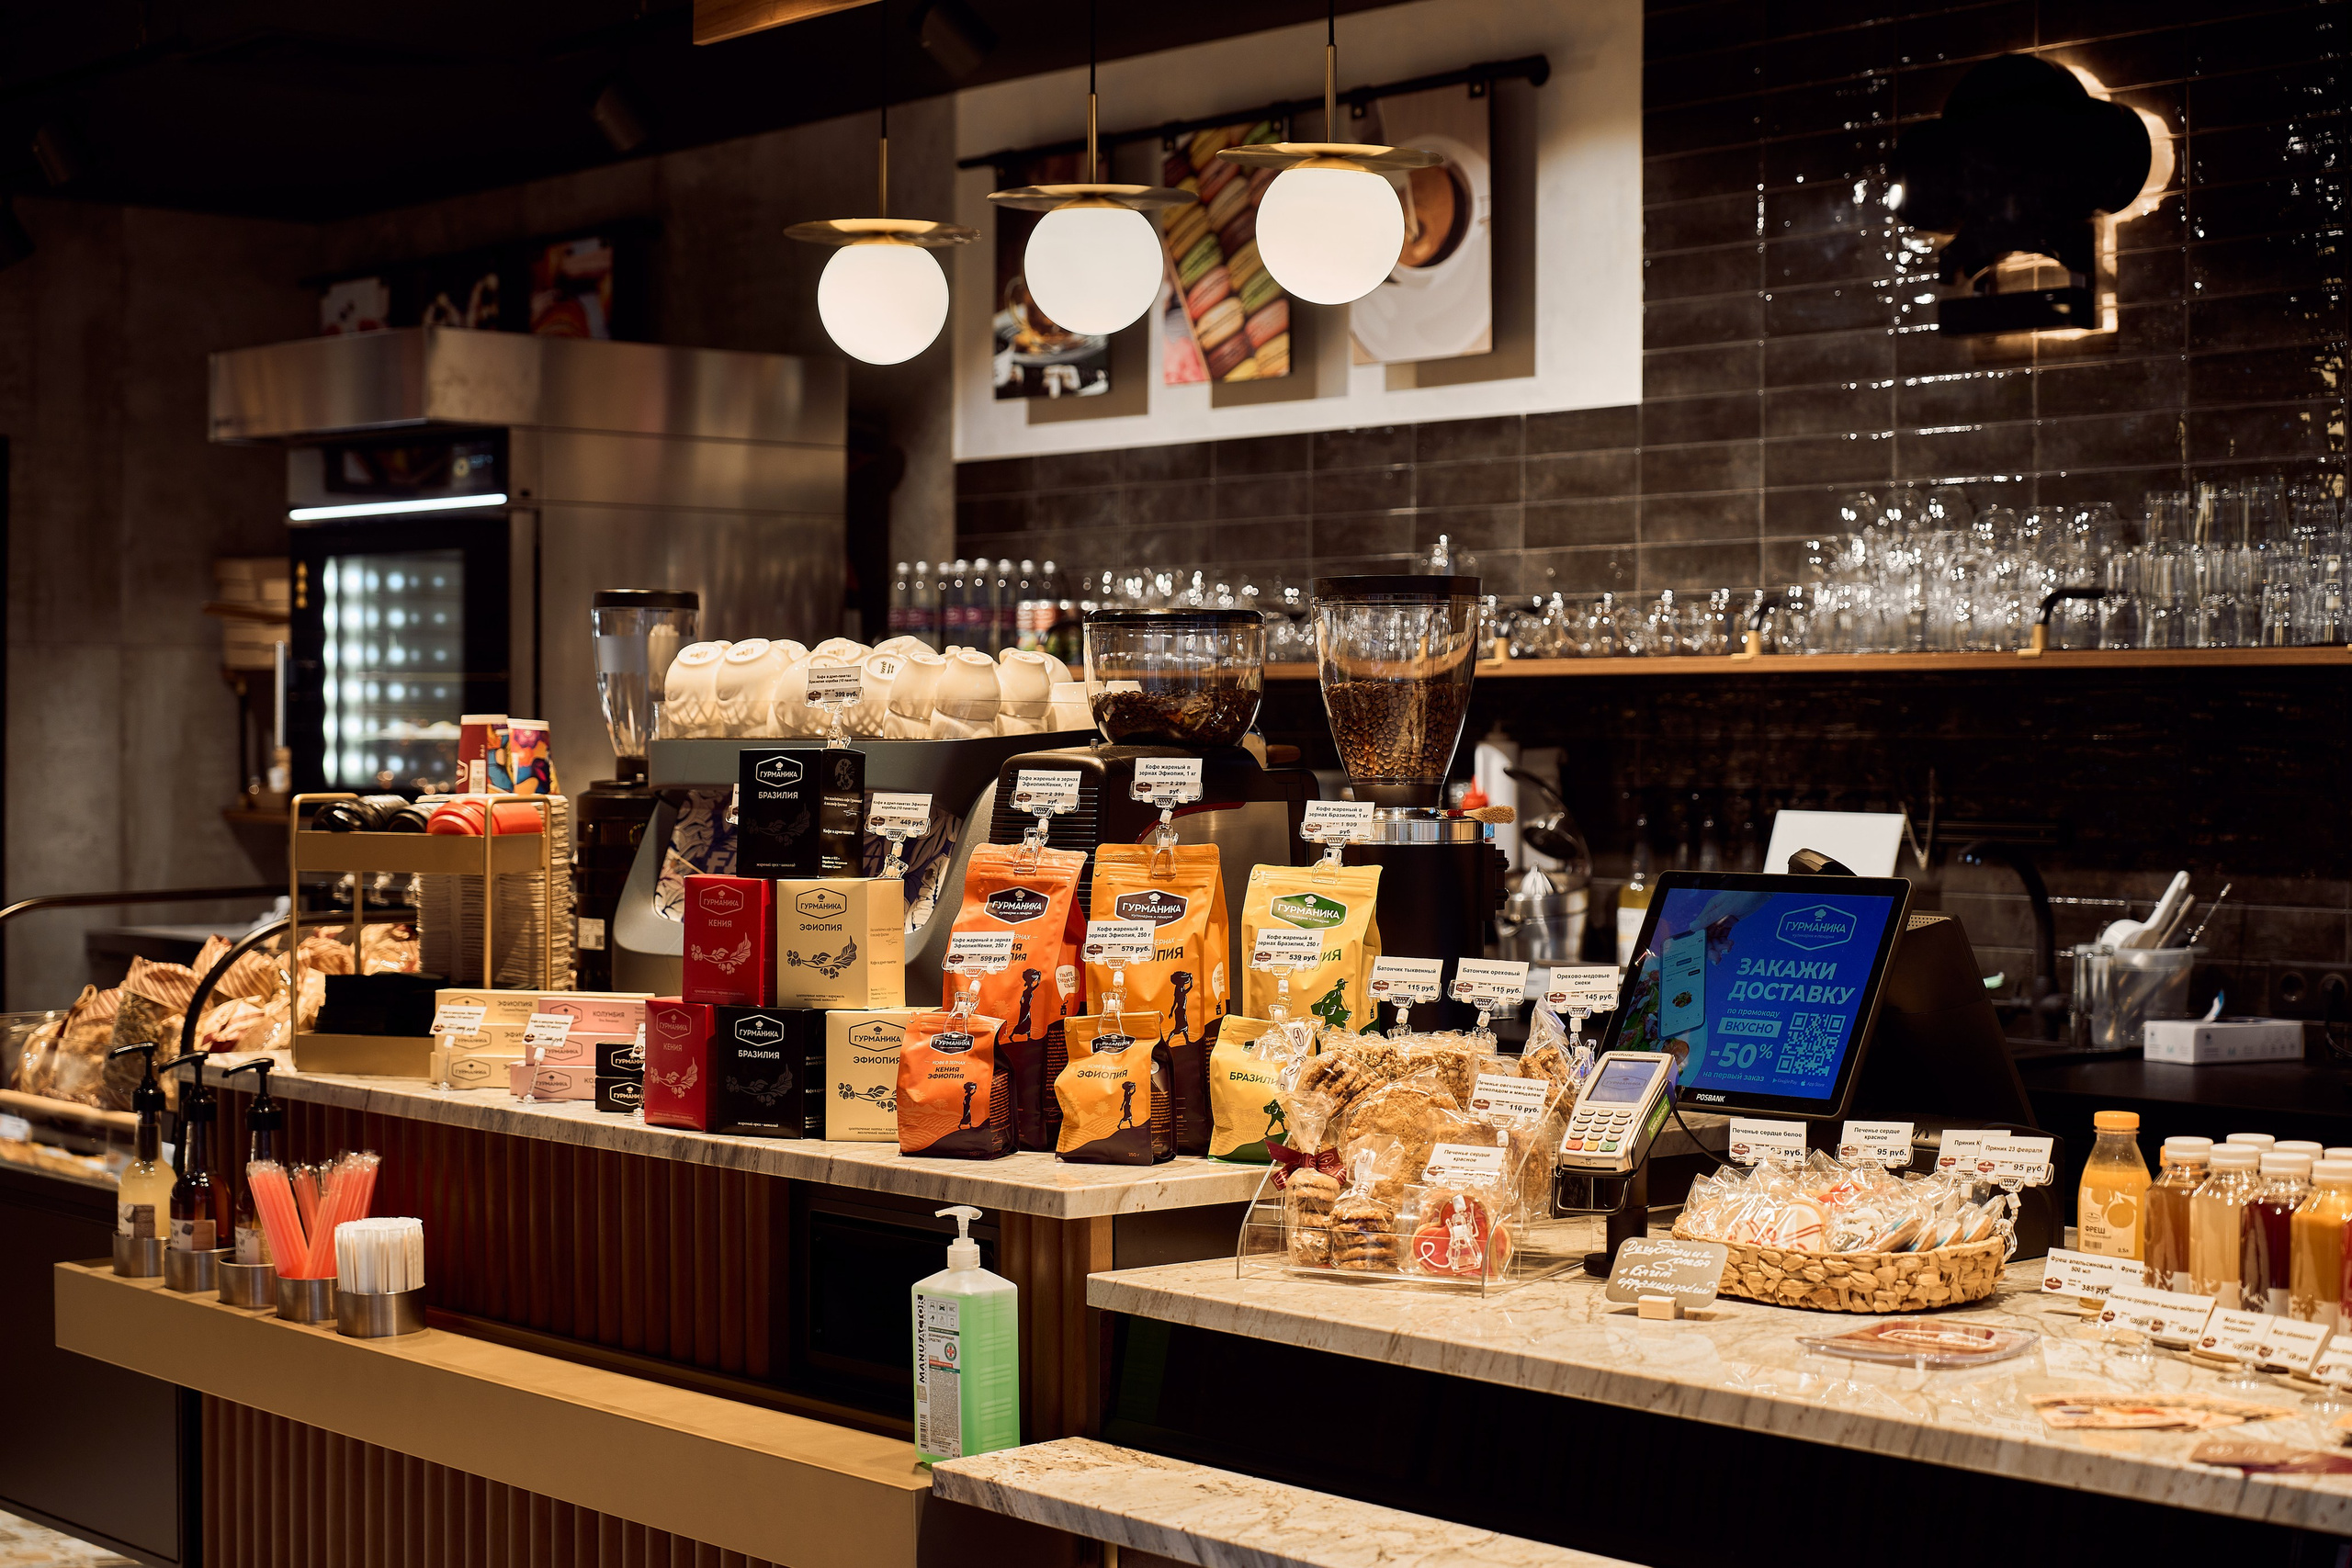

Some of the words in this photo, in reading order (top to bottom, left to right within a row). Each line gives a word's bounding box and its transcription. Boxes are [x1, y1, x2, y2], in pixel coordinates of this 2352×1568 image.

[1161, 763, 1185, 772] жареный
[760, 771, 798, 779] ГУРМАНИКА
[758, 791, 799, 800] БРАЗИЛИЯ
[912, 819, 925, 828] руб.
[703, 897, 740, 908] ГУРМАНИКА
[800, 901, 842, 911] ГУРМАНИКА
[991, 901, 1043, 911] ГУРМАНИКА
[1121, 902, 1182, 914] ГУРМАНИКА
[1277, 904, 1341, 919] ГУРМАНИКА
[707, 919, 733, 929] КЕНИЯ
[799, 923, 842, 932] ЭФИОПИЯ
[1785, 921, 1846, 933] ГУРМАНИКА
[1135, 945, 1150, 953] руб.
[1736, 957, 1838, 980] ЗАКАЖИ
[1599, 993, 1614, 1001] руб.
[1727, 980, 1856, 1005] ДОСТАВКУ
[1737, 1010, 1781, 1019] промокоду
[659, 1021, 688, 1032] ГУРМАНИКА
[1724, 1021, 1774, 1034] ВКУСНО
[739, 1028, 780, 1039] ГУРМАНИКА
[853, 1034, 901, 1043] ГУРМАНИКА
[663, 1043, 684, 1053] КЕНИЯ
[738, 1048, 781, 1060] БРАЗИЛИЯ
[1710, 1042, 1774, 1069] -50%
[1077, 1069, 1128, 1080] ЭФИОПИЯ
[1695, 1093, 1726, 1102] POSBANK
[1510, 1103, 1522, 1111] 110
[1523, 1106, 1541, 1114] руб.
[1784, 1149, 1804, 1157] руб.
[1889, 1149, 1907, 1157] руб.
[2013, 1163, 2024, 1171] 95
[2086, 1225, 2106, 1235] ФРЕШ
[2051, 1255, 2067, 1263] Фреш
[2120, 1266, 2137, 1274] Фреш
[917, 1294, 926, 1384] MANUFACTOR
